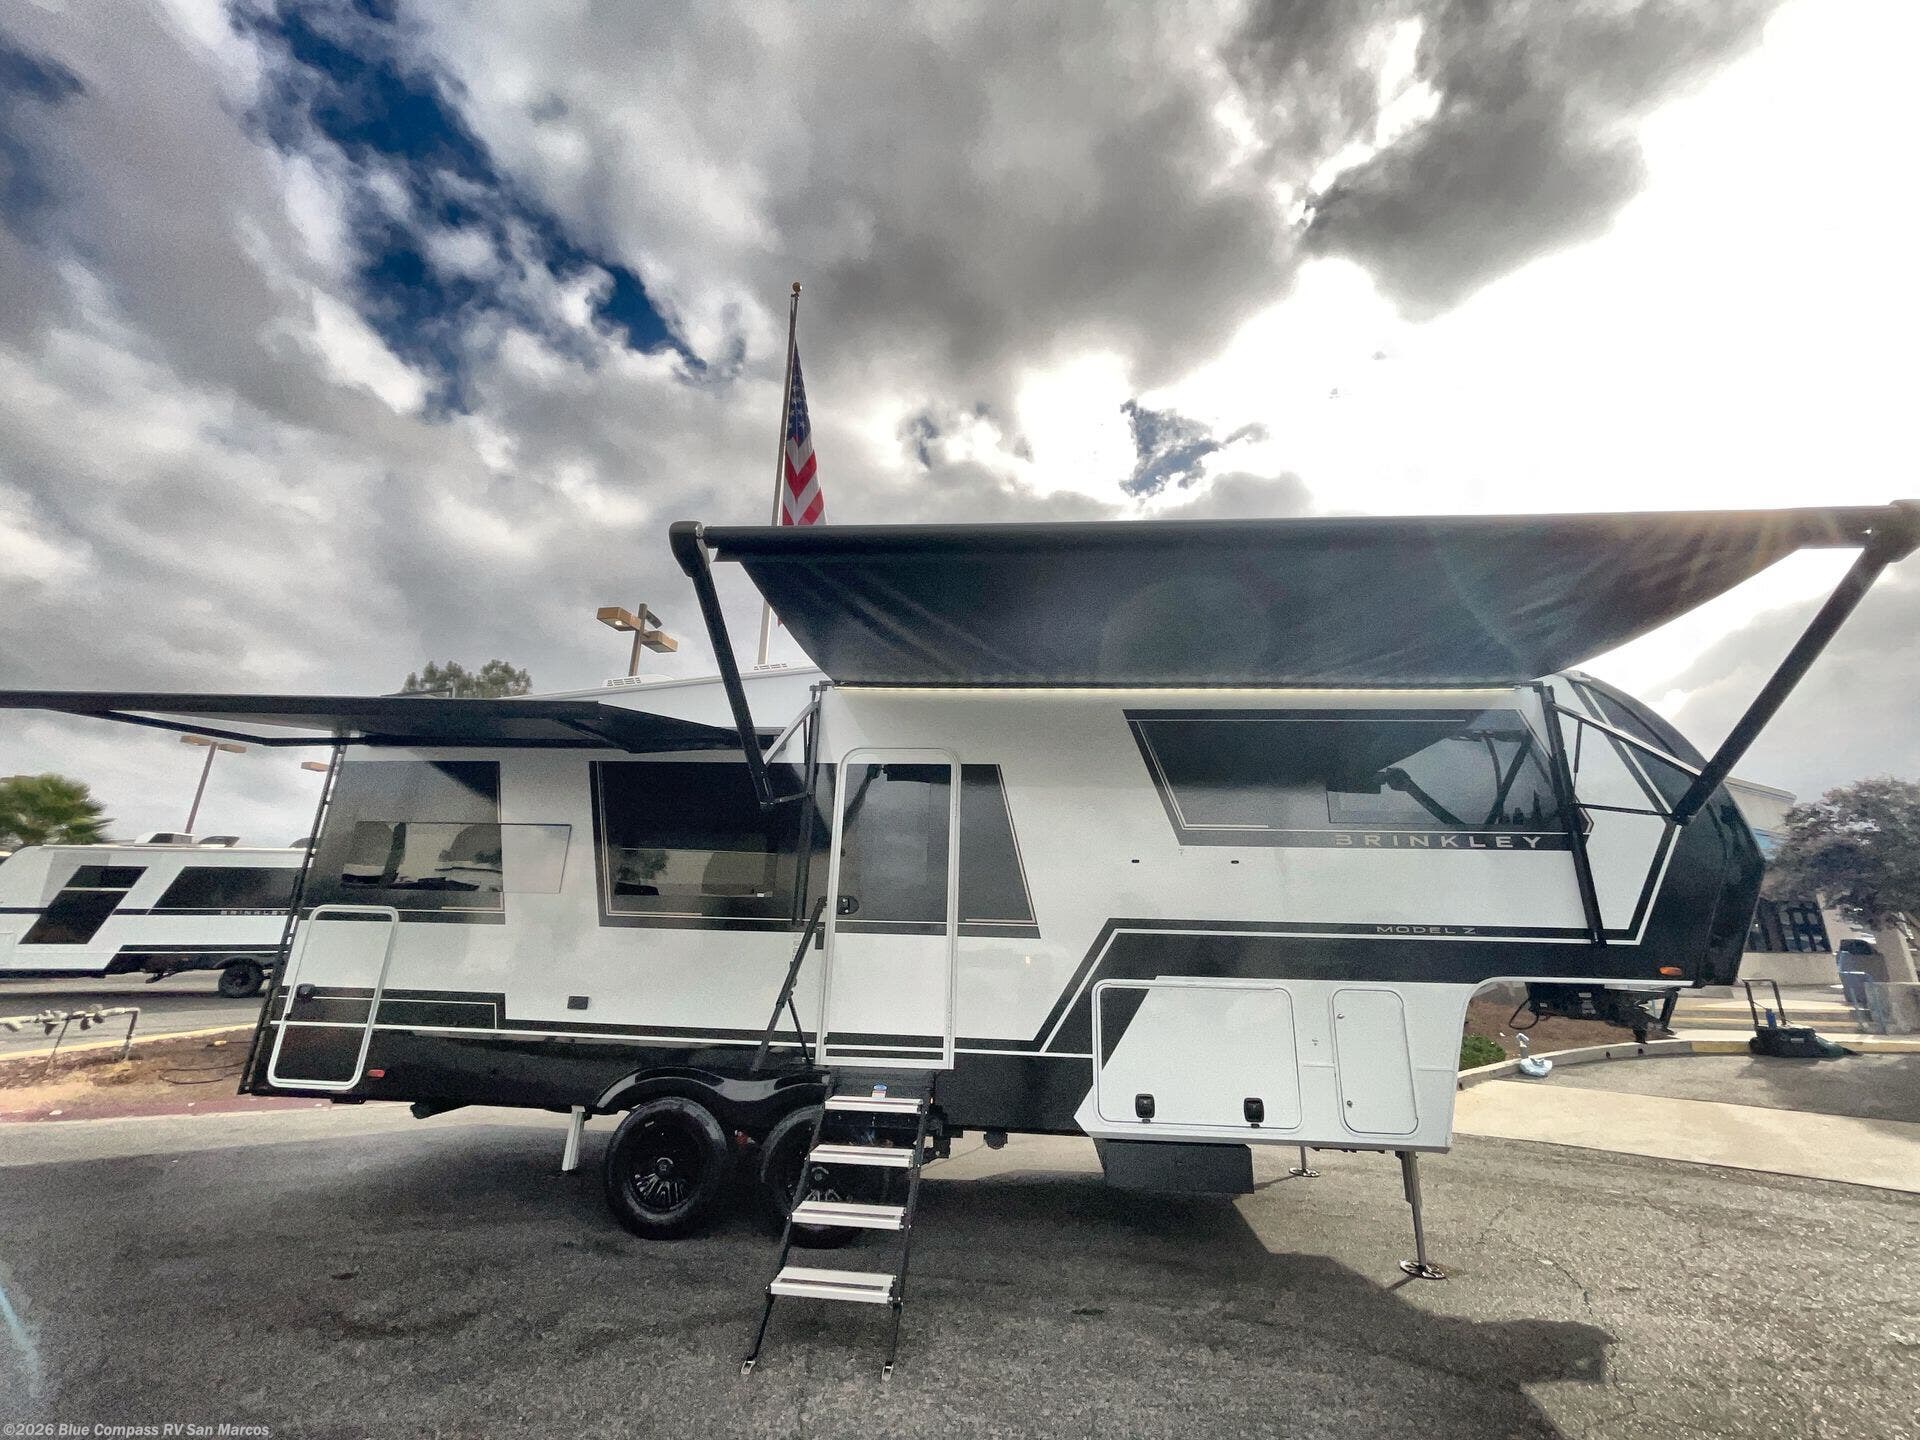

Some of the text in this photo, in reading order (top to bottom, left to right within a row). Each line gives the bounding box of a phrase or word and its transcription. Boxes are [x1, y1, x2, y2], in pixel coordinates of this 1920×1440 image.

[1335, 834, 1541, 849] BRINKLEY
[1376, 925, 1476, 935] MODEL Z
